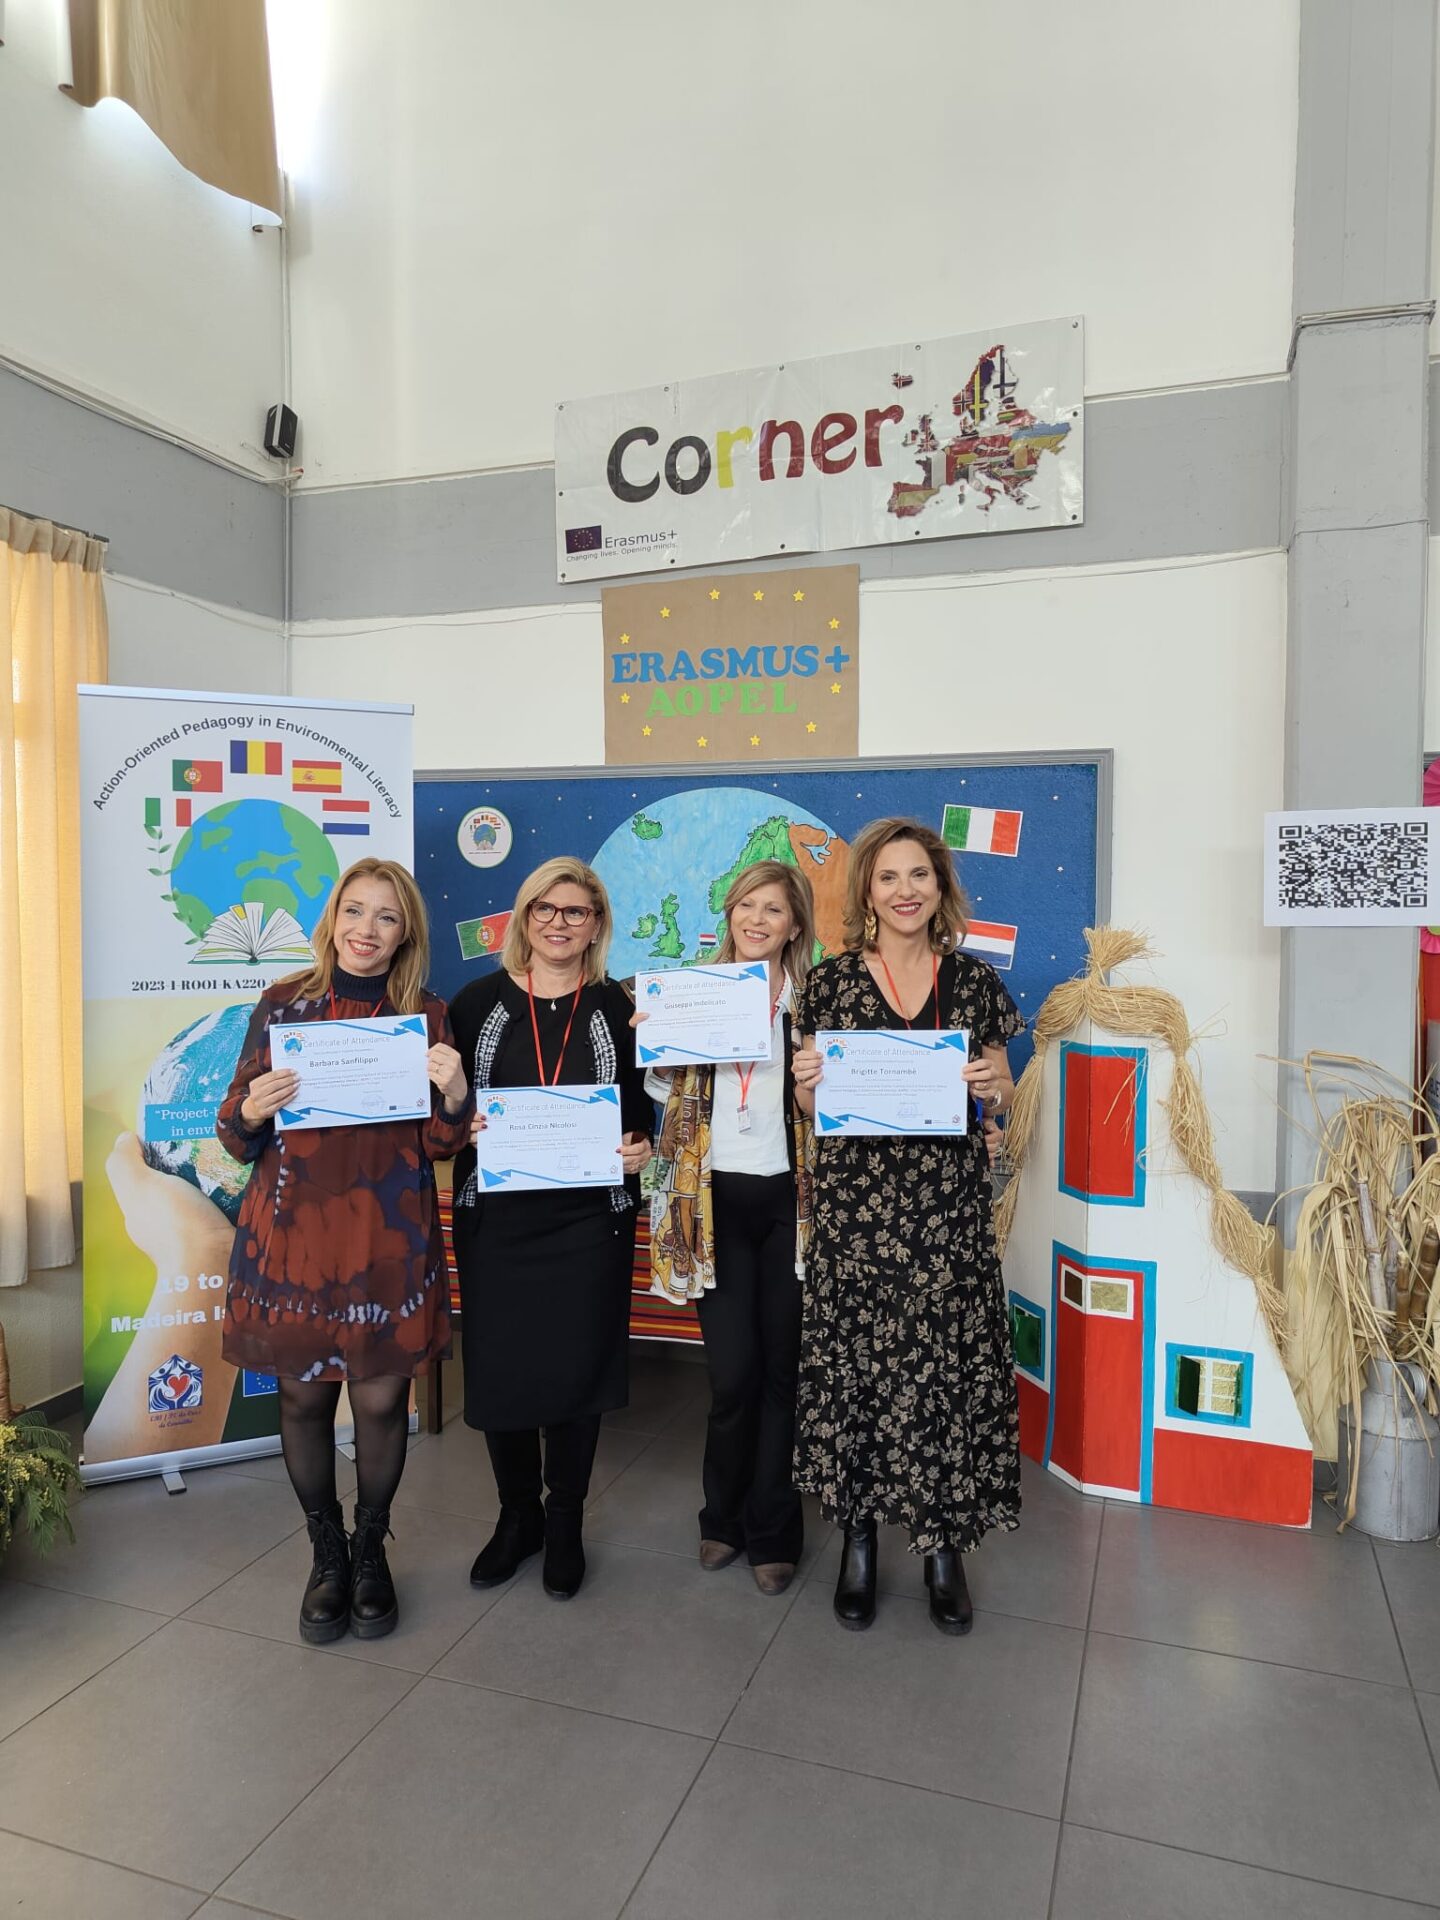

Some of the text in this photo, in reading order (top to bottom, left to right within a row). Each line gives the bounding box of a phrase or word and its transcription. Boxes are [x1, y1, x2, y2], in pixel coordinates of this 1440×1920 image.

[607, 404, 904, 503] Corner
[605, 529, 677, 548] Erasmus+
[566, 542, 677, 562] Changing lives. Opening minds.
[645, 681, 798, 718] AOPEL
[93, 715, 402, 819] Action-Oriented Pedagogy in Environmental Literacy
[304, 1039, 340, 1048] Certificate
[351, 1036, 390, 1045] Attendance
[847, 1048, 881, 1056] Certificate
[892, 1047, 931, 1056] Attendance
[309, 1056, 379, 1068] Barbara Sanfilippo
[851, 1067, 878, 1076] Brigitte
[171, 1125, 184, 1136] in
[549, 1121, 577, 1129] Nicolosi
[198, 1273, 224, 1290] to
[111, 1309, 207, 1333] Madeira
